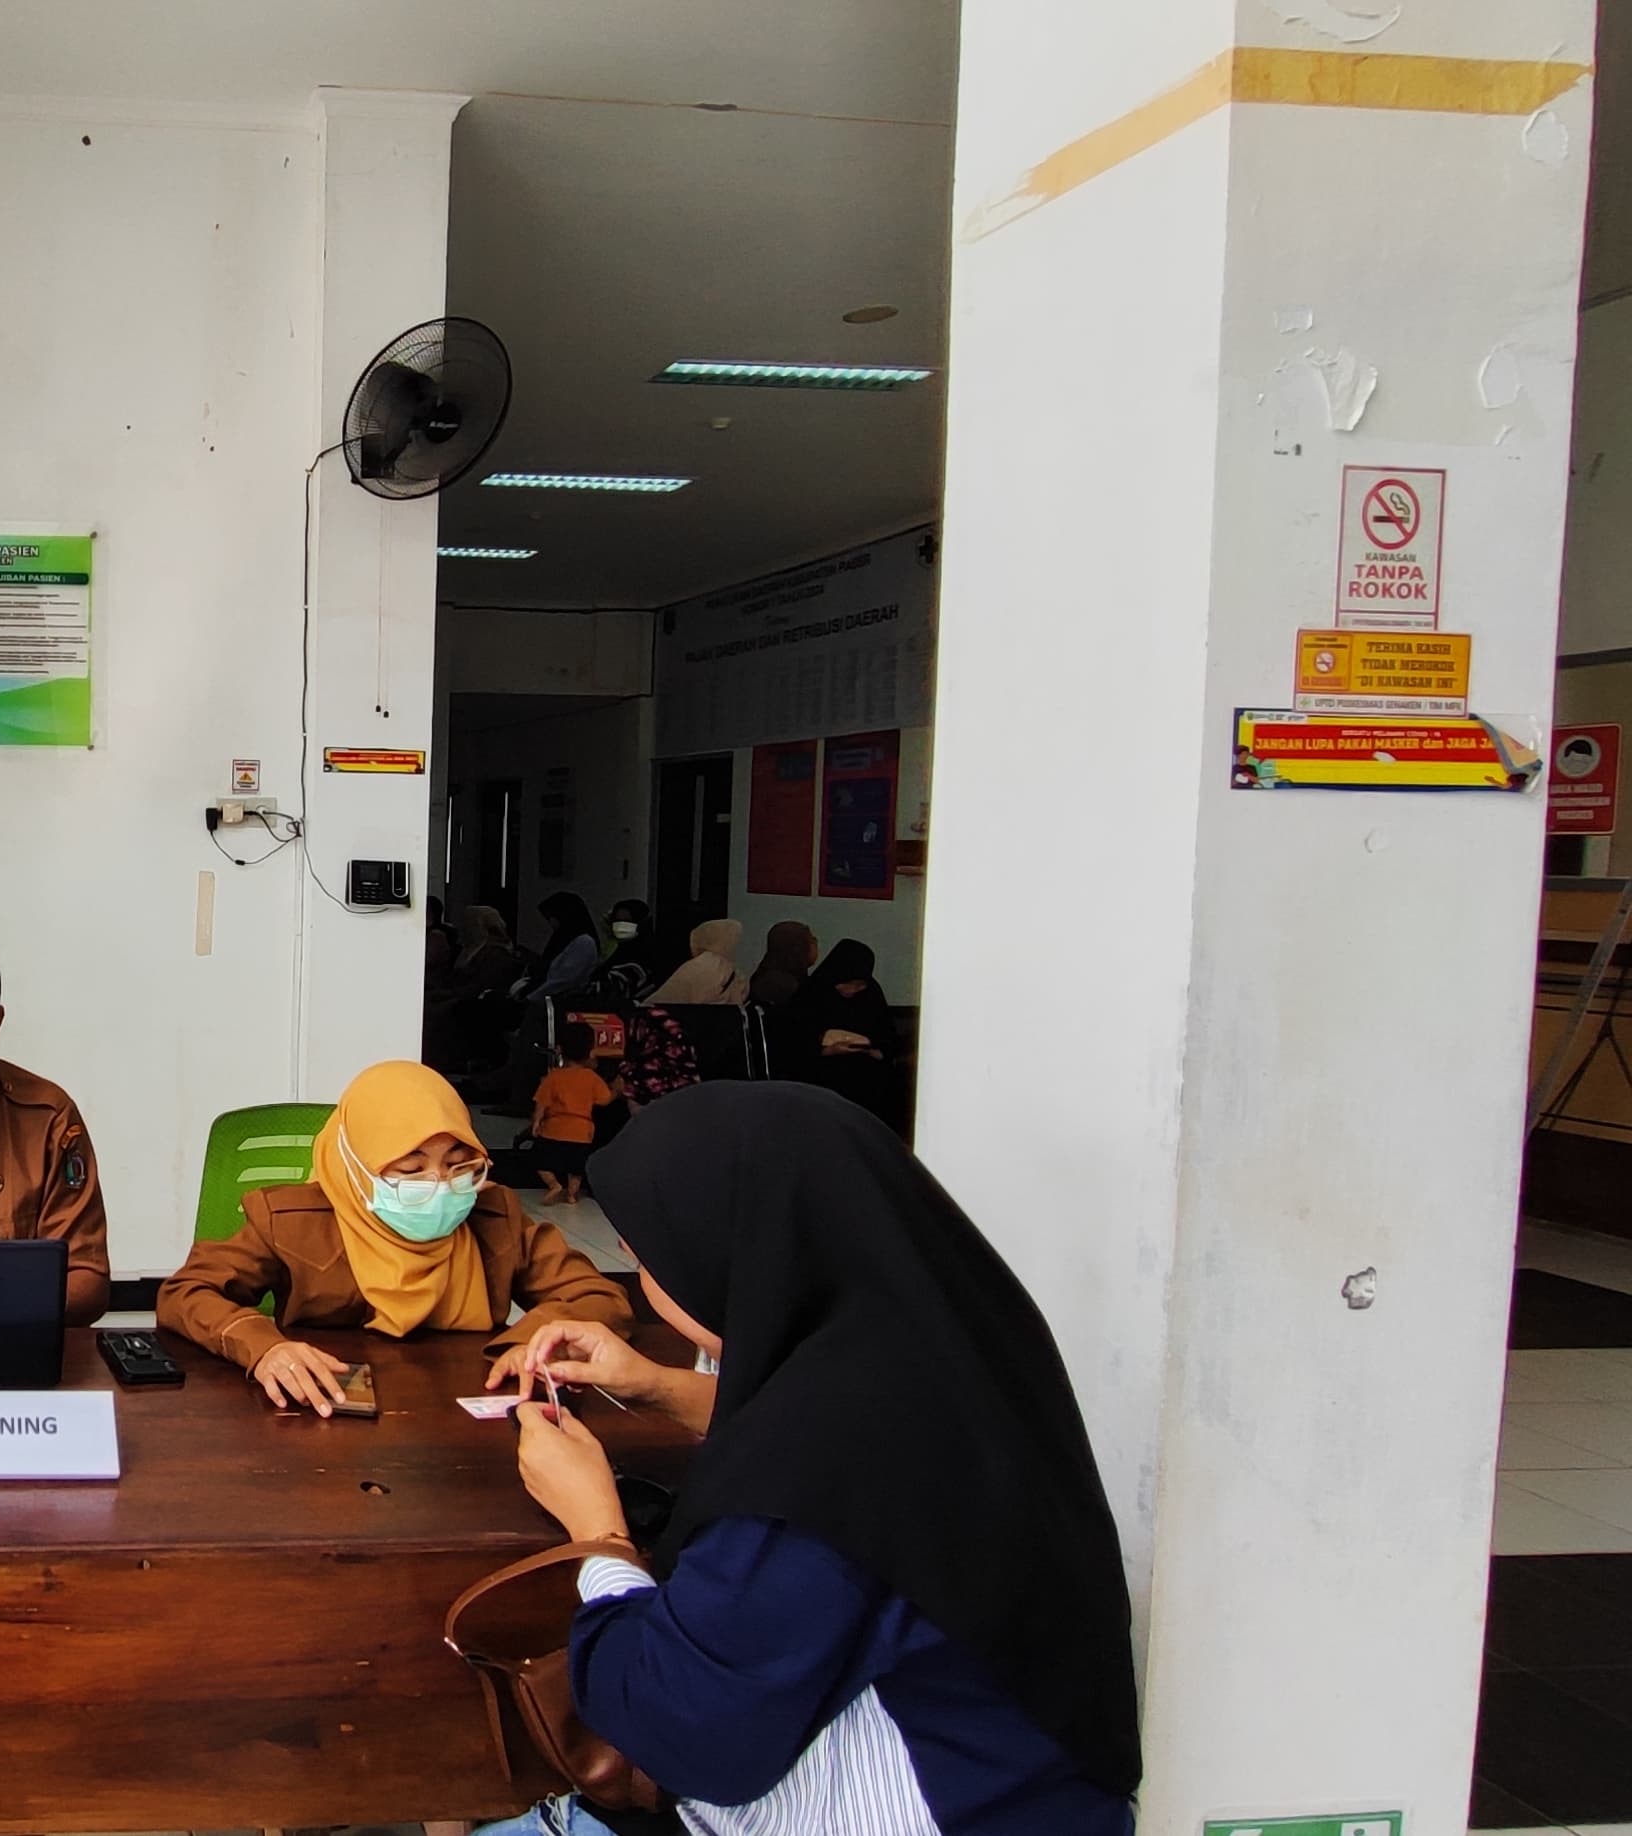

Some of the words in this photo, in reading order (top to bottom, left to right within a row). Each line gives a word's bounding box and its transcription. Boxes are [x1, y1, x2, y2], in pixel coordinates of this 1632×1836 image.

[1365, 552, 1417, 563] KAWASAN
[28, 575, 61, 583] PASIEN
[1354, 564, 1424, 581] TANPA
[1348, 581, 1428, 600] ROKOK
[783, 618, 843, 644] RETRIBUSI
[845, 603, 900, 631] DAERAH
[1367, 641, 1413, 654] TERIMA
[1416, 643, 1451, 655] KASIH
[1361, 658, 1396, 671] TIDAK
[1254, 738, 1303, 750] JANGAN
[1305, 738, 1335, 750] LUPA
[1337, 738, 1372, 750] PAKAI
[1374, 738, 1419, 749] MASKER
[1422, 738, 1444, 749] dan
[1446, 738, 1477, 749] JAGA
